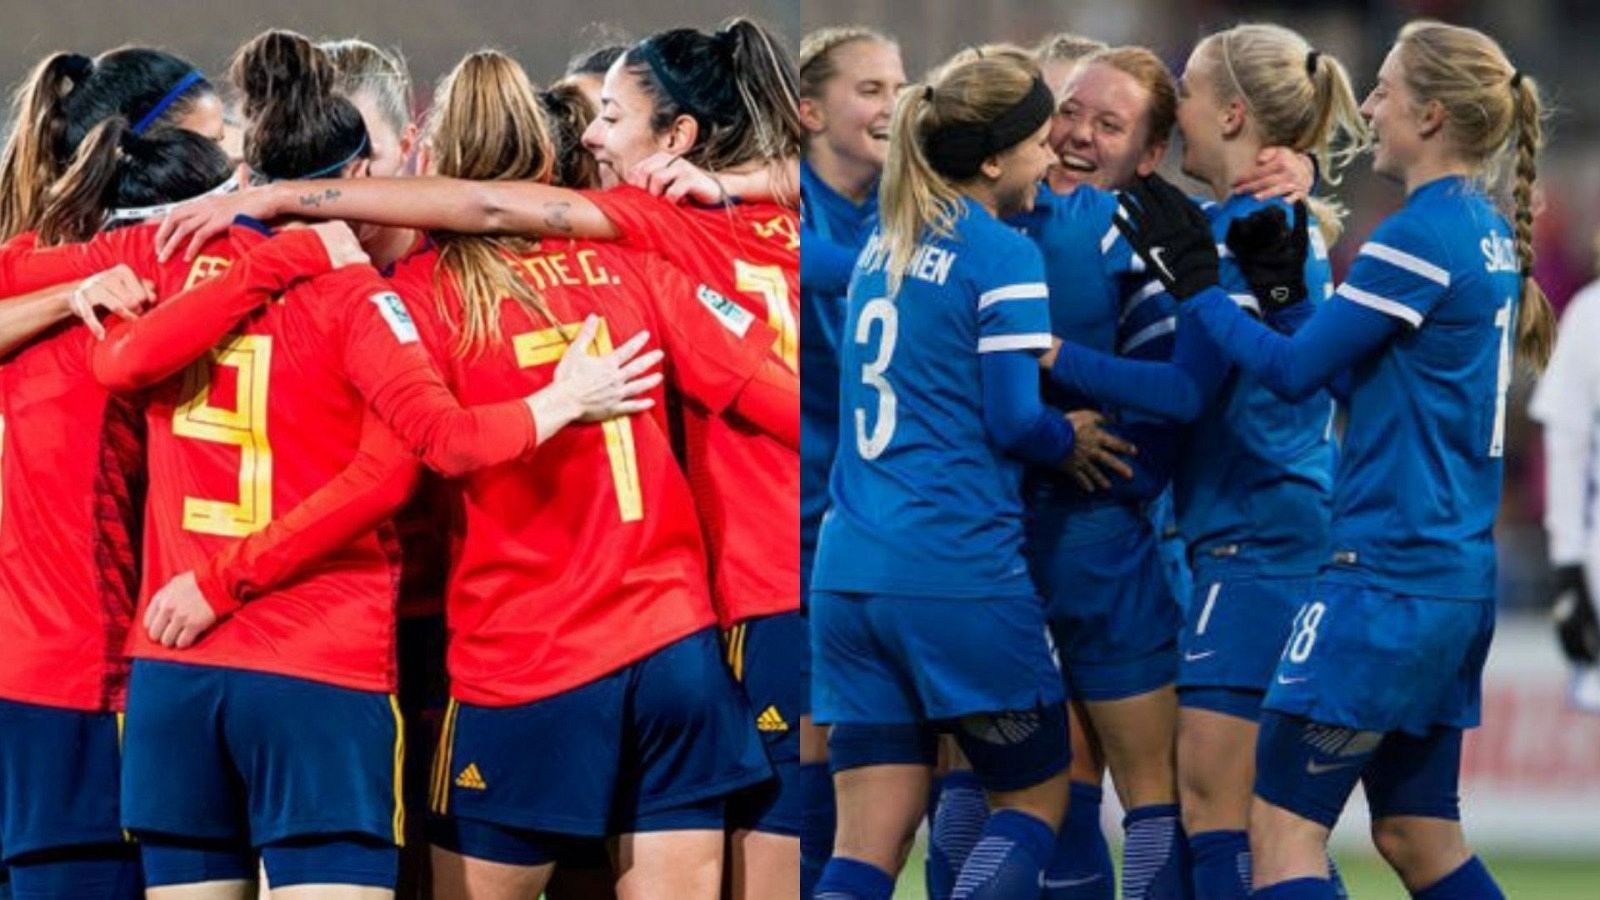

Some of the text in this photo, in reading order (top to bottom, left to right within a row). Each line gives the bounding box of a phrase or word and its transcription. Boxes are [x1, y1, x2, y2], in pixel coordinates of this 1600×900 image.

[577, 248, 621, 287] G.
[172, 334, 273, 538] 9
[512, 316, 644, 523] 7
[855, 297, 898, 461] 3
[1489, 297, 1518, 458] 1
